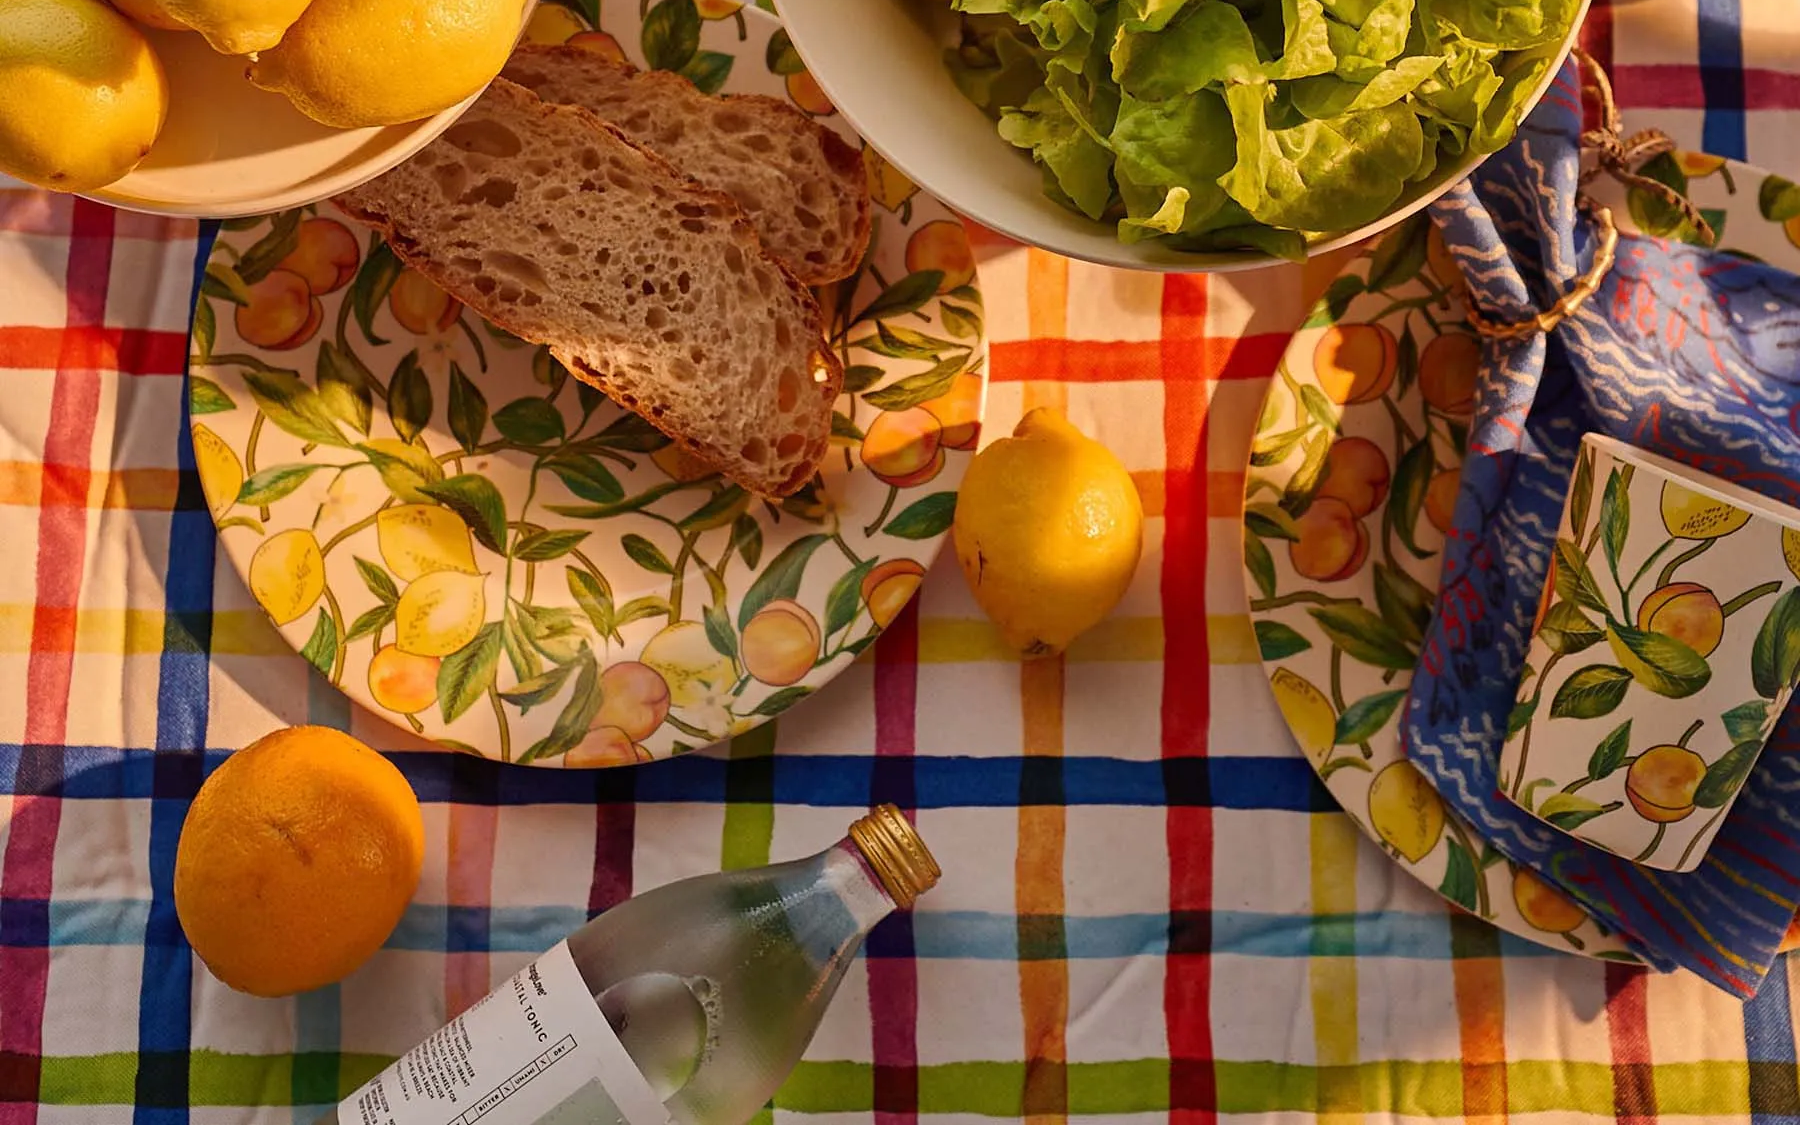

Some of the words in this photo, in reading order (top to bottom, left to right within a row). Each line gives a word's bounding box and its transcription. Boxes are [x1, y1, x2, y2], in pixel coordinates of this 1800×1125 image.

[524, 1005, 548, 1043] TONIC
[444, 1061, 458, 1084] COASTAL
[454, 1063, 470, 1087] VIBRANT
[463, 1060, 475, 1077] MIXER
[478, 1094, 499, 1111] BITTER
[514, 1067, 536, 1085] UMAMI
[553, 1045, 566, 1056] DRY
[423, 1080, 434, 1099] BEACH
[430, 1075, 445, 1099] BECAUSE
[439, 1071, 450, 1090] MAKES
[448, 1089, 457, 1103] FOR
